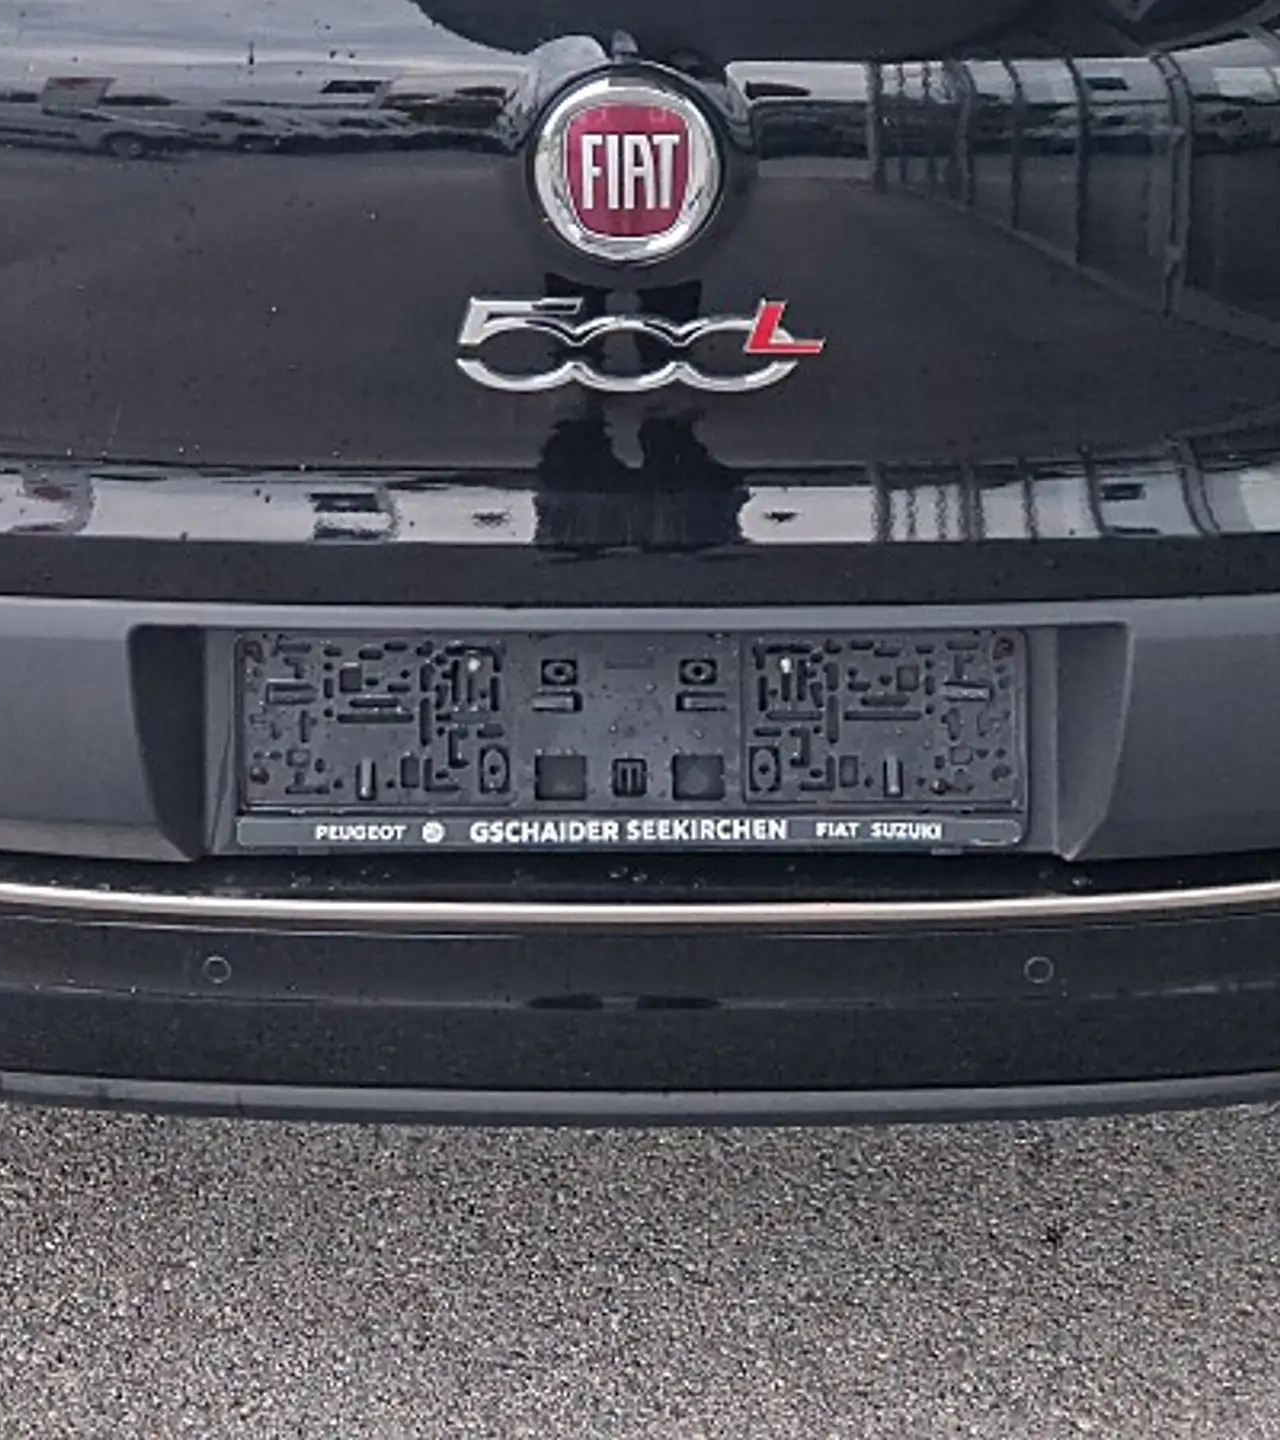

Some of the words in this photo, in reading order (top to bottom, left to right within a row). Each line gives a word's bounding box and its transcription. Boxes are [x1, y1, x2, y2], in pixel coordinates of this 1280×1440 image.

[579, 133, 681, 211] FIAT
[315, 823, 408, 842] PEUGEOT
[469, 819, 619, 844] GSCHAIDER
[626, 818, 788, 841] SEEKIRCHEN
[815, 822, 860, 839] FIAT
[870, 822, 943, 840] SUZUKI
